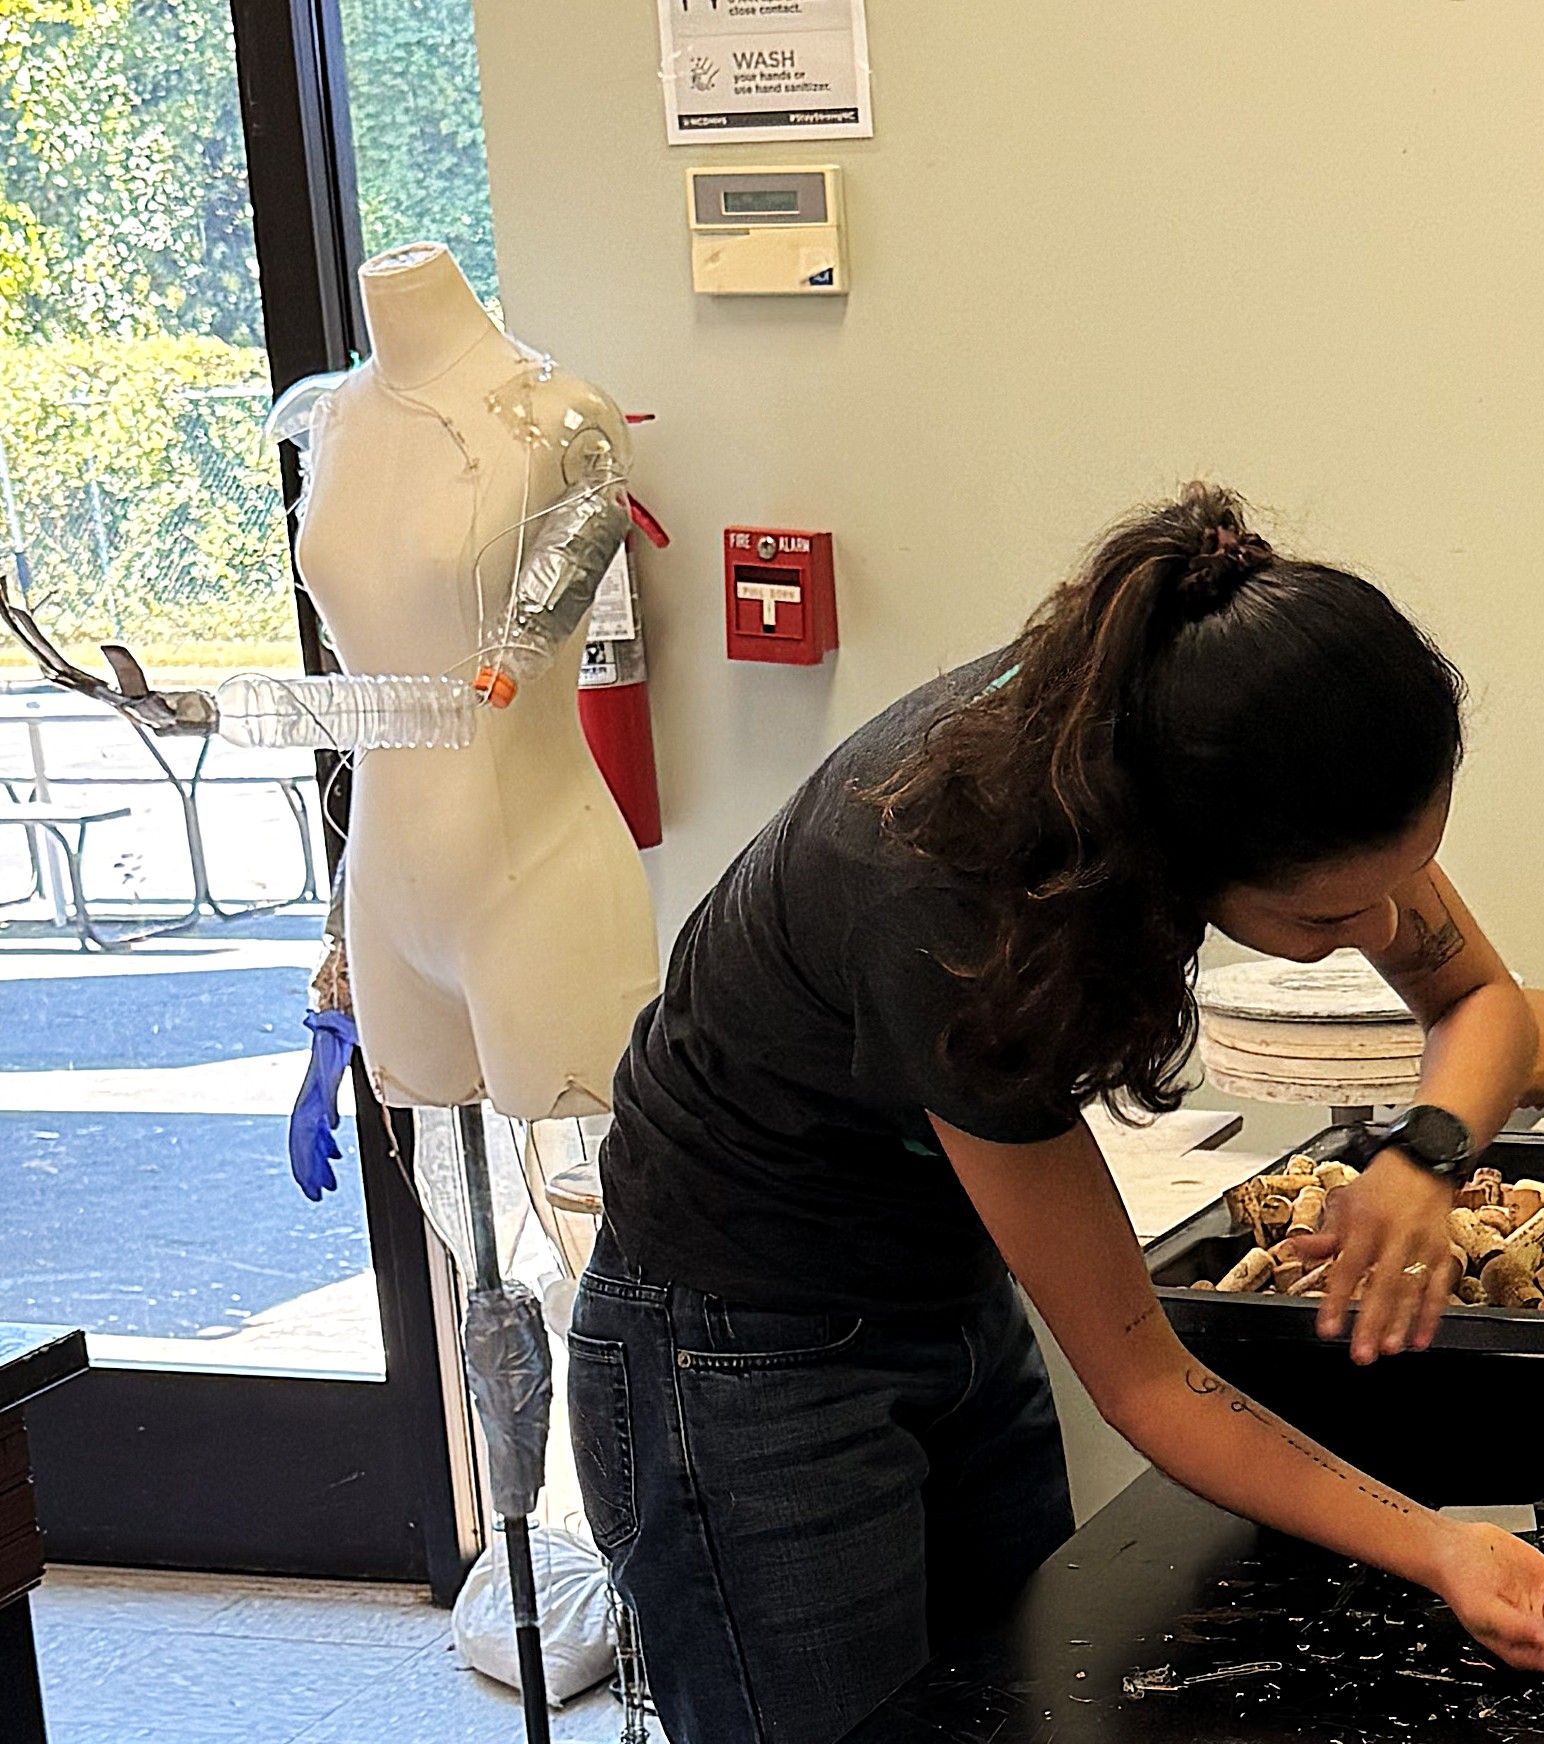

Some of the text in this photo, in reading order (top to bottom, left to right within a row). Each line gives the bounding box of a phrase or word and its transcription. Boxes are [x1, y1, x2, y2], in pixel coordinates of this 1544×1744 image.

[733, 50, 795, 69] WASH
[733, 70, 806, 84] your hands or
[734, 86, 752, 95] use
[755, 83, 782, 94] hand
[729, 533, 811, 553] FIRE ALARM
